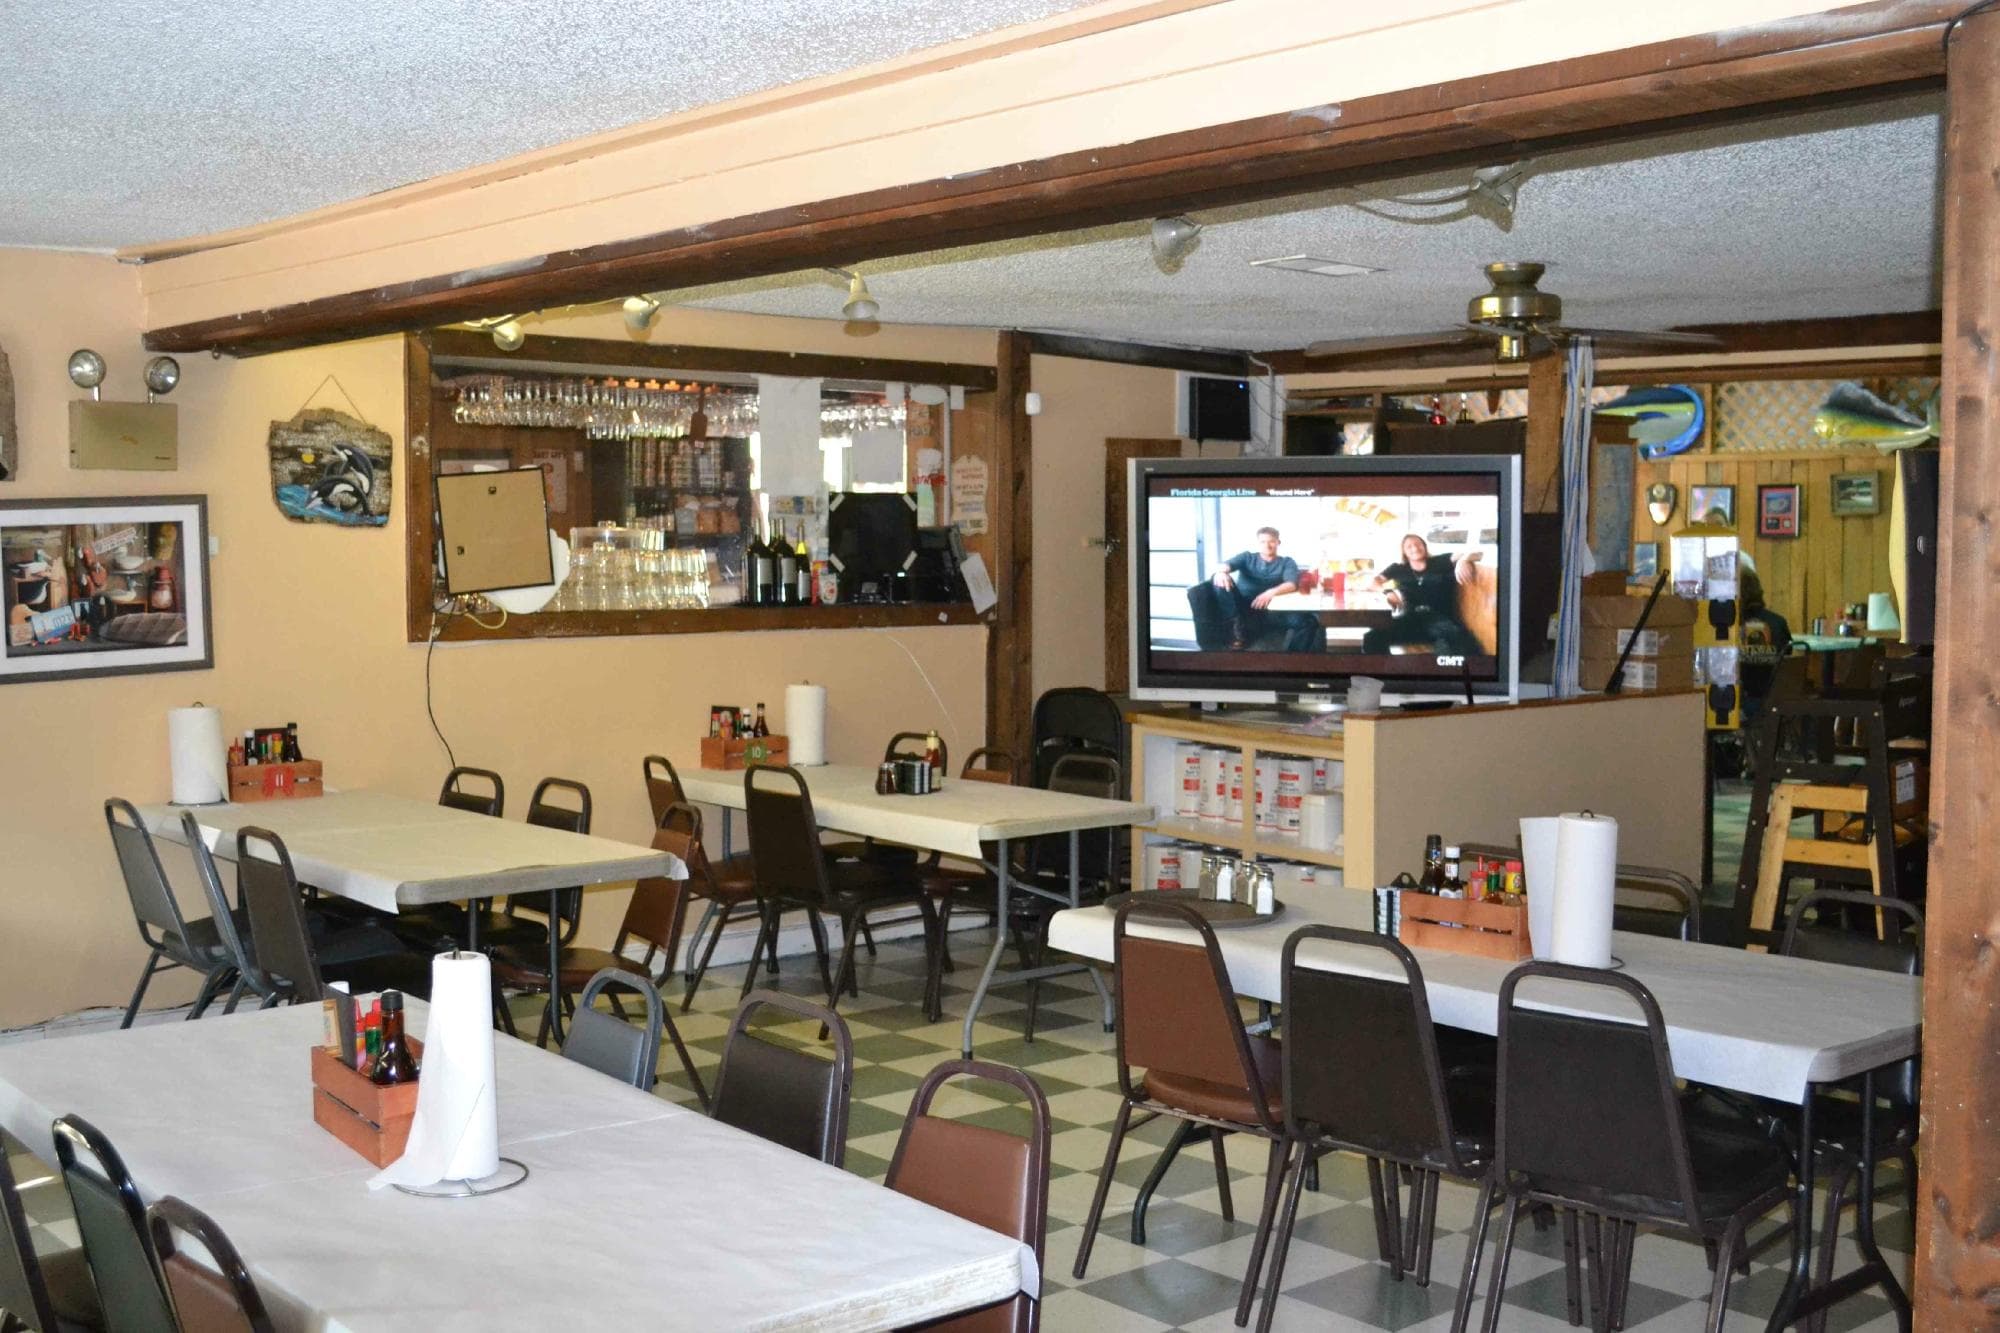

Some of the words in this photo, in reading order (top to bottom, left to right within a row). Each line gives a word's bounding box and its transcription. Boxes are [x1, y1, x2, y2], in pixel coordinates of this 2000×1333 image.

[1170, 488, 1201, 497] Florida
[1203, 488, 1235, 498] Georgia
[1237, 488, 1257, 497] Line
[1436, 656, 1465, 667] CMT
[751, 745, 762, 759] 10
